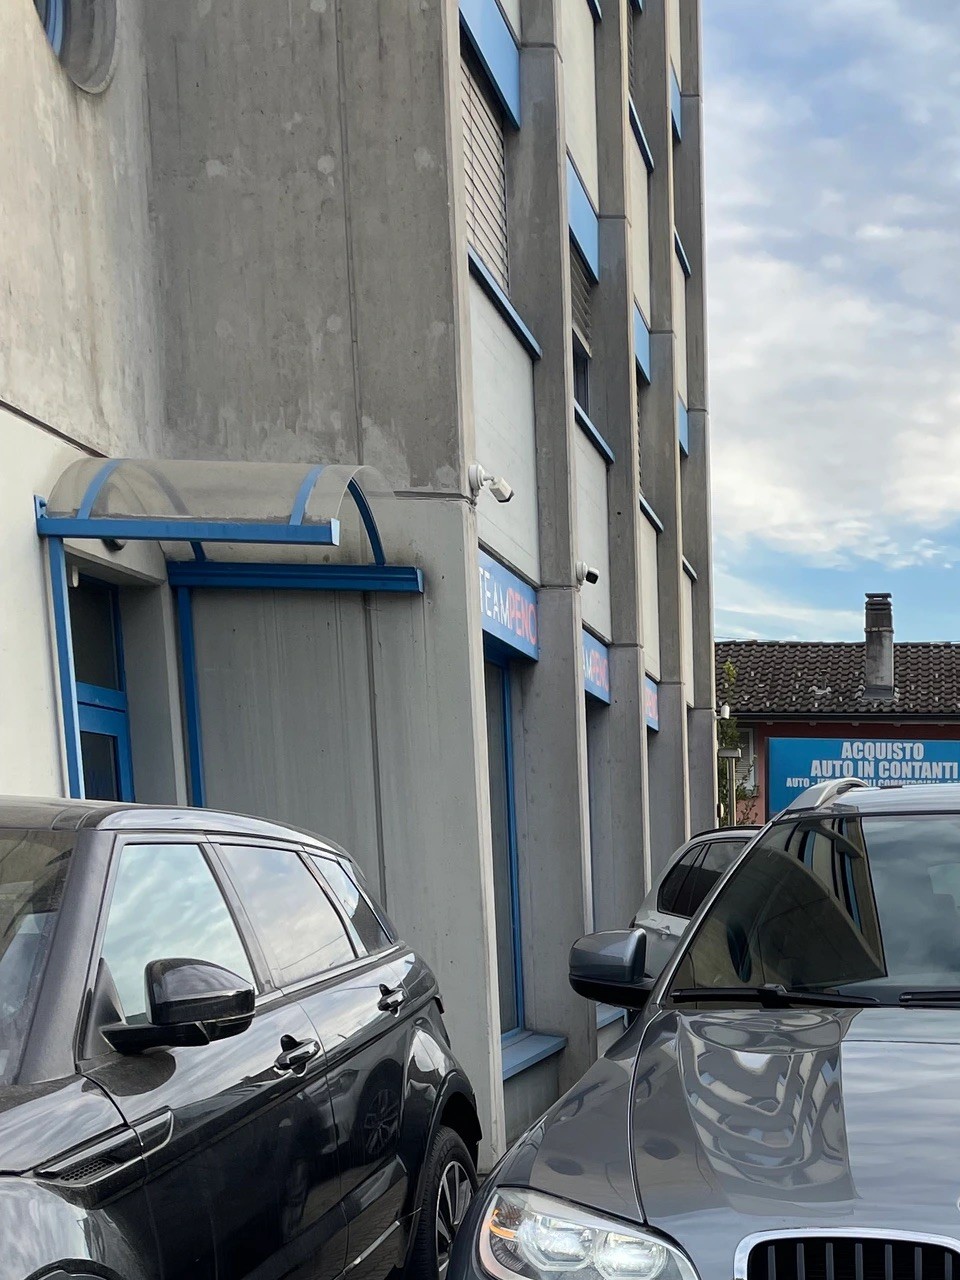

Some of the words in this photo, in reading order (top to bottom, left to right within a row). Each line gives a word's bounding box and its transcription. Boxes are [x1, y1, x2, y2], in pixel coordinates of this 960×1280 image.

[841, 741, 925, 761] ACQUISTO
[811, 761, 854, 778] AUTO
[857, 761, 875, 778] IN
[878, 761, 959, 779] CONTANTI
[786, 777, 810, 788] AUTO
